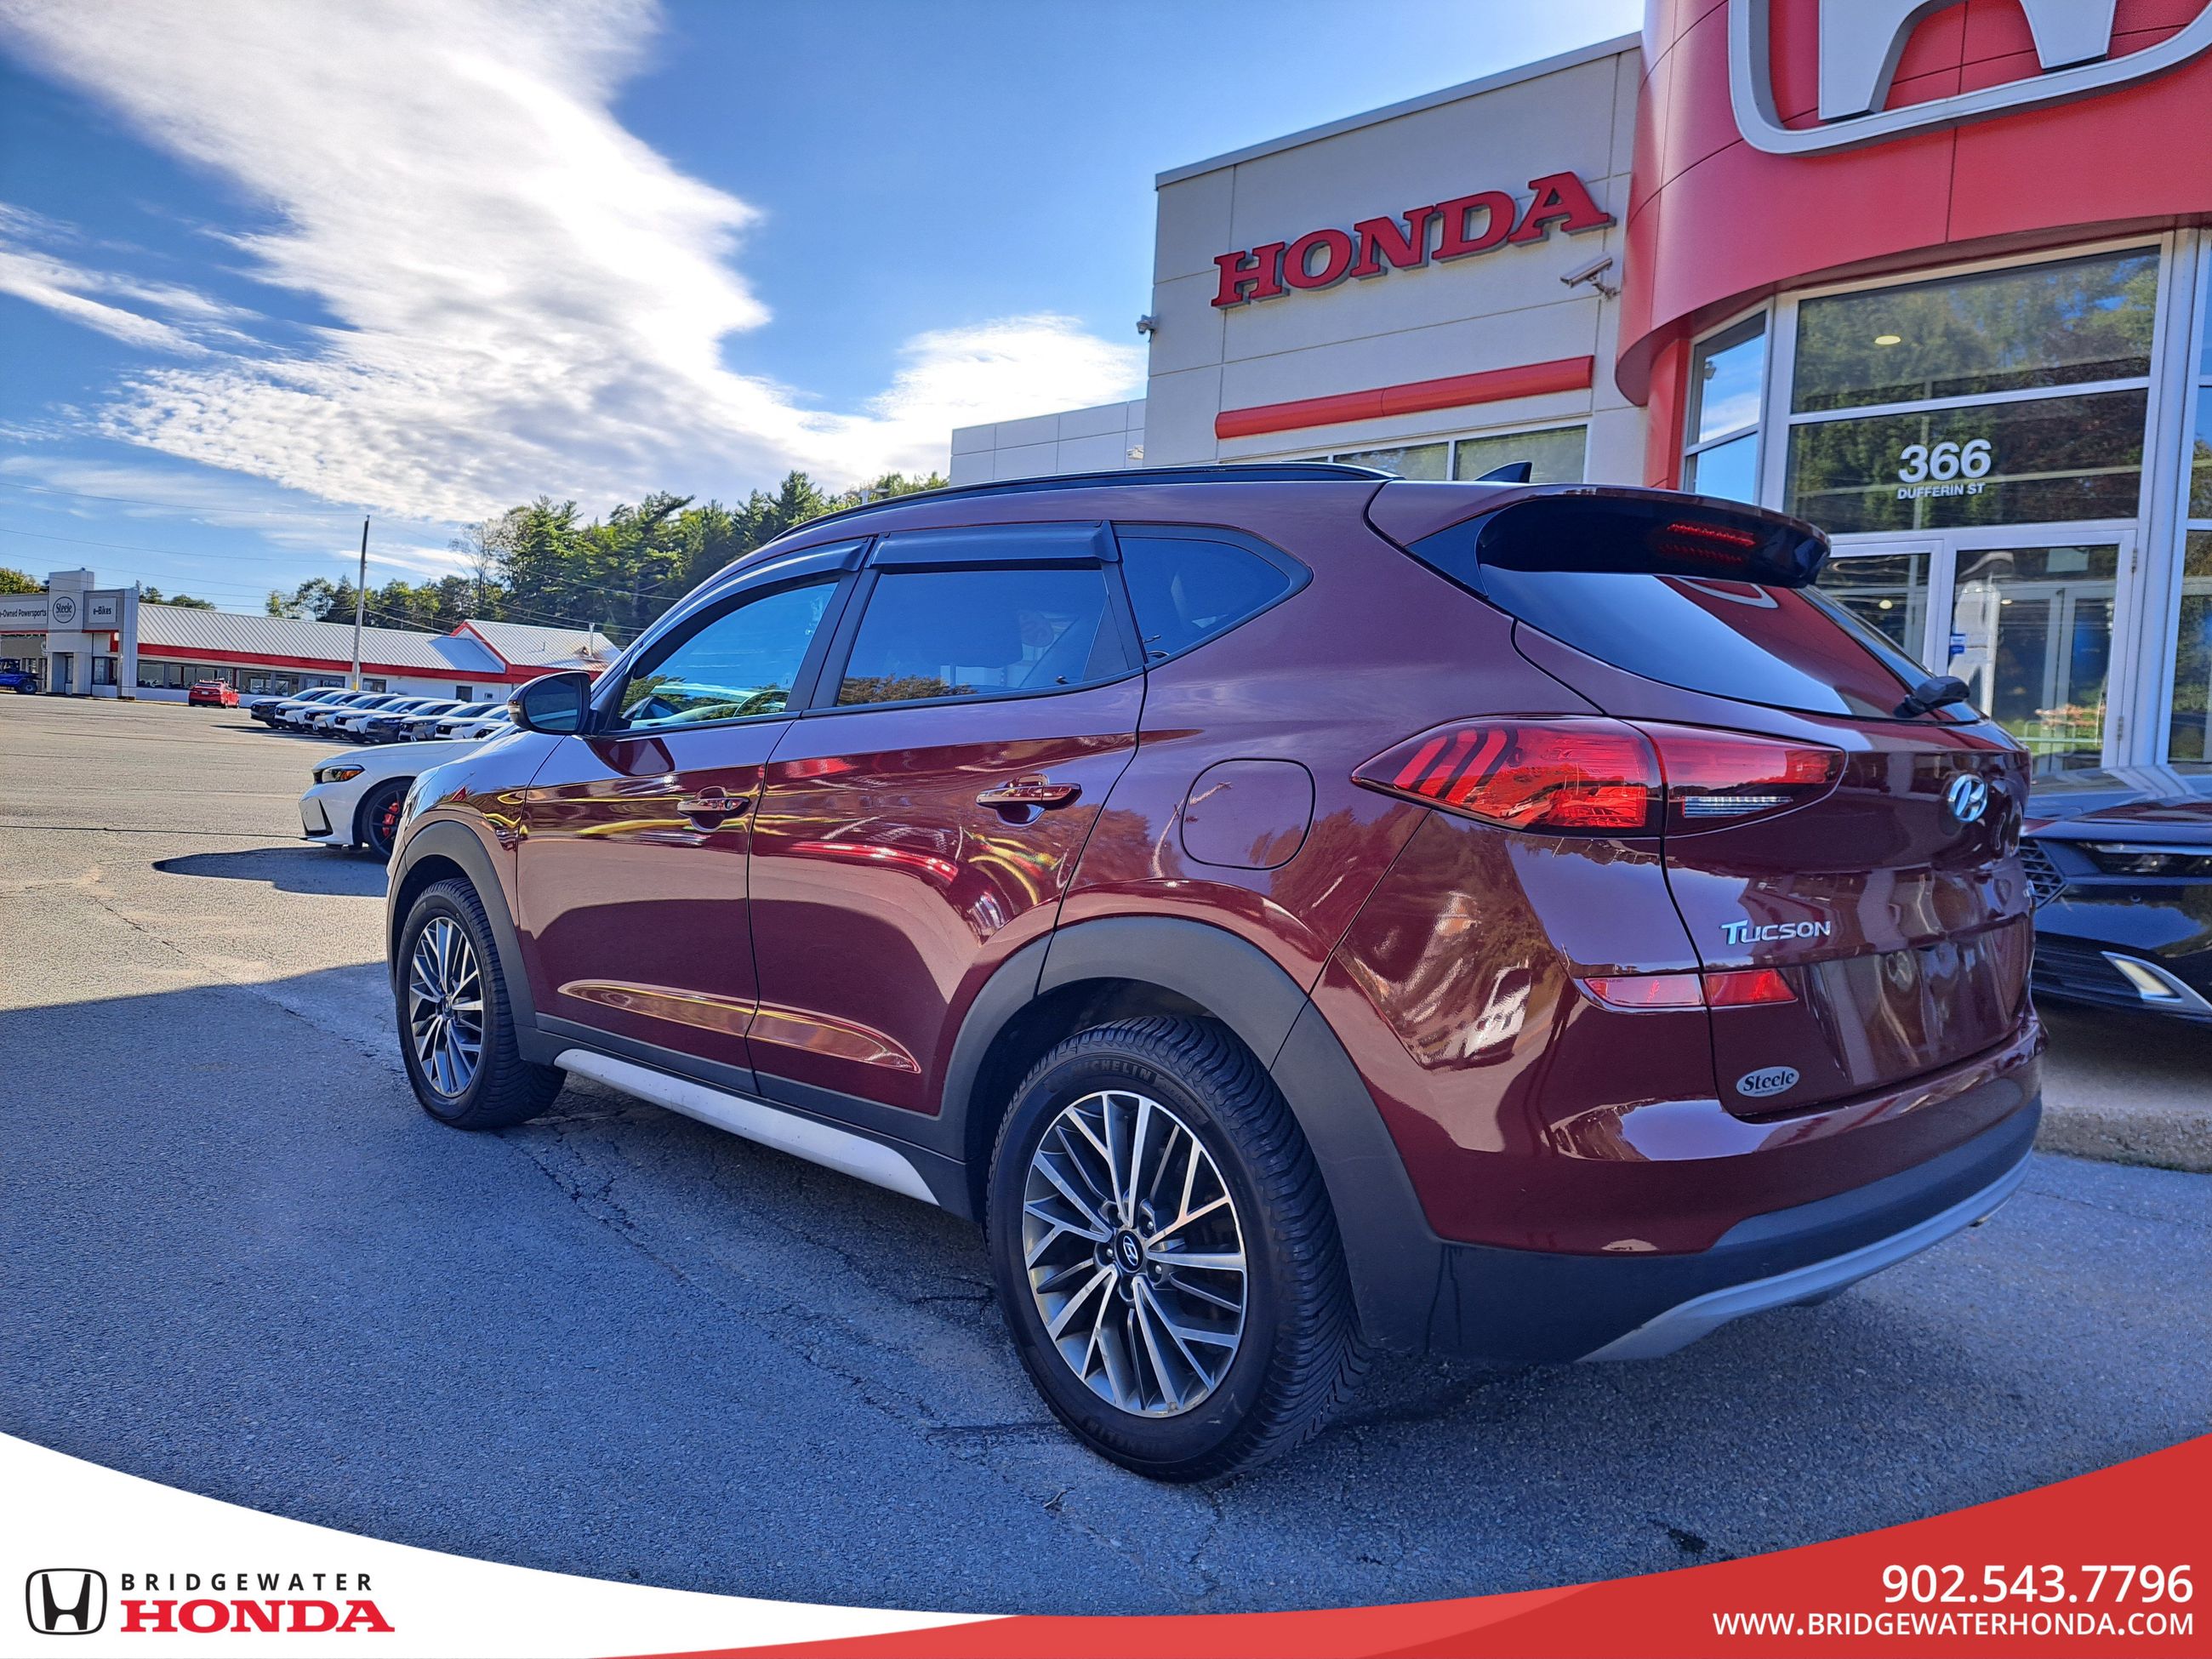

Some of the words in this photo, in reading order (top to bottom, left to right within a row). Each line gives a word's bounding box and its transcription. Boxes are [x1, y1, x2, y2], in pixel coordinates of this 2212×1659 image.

[1211, 171, 1613, 308] HONDA
[1898, 439, 1992, 483] 366
[1897, 484, 1964, 500] DUFFERIN
[1967, 482, 1987, 495] ST
[0, 608, 18, 618] -Owned
[19, 608, 47, 619] Powersports
[55, 602, 72, 613] Steele
[93, 605, 111, 615] e-Bikes
[1720, 919, 1831, 945] TUCSON
[1742, 1070, 1795, 1092] Steele
